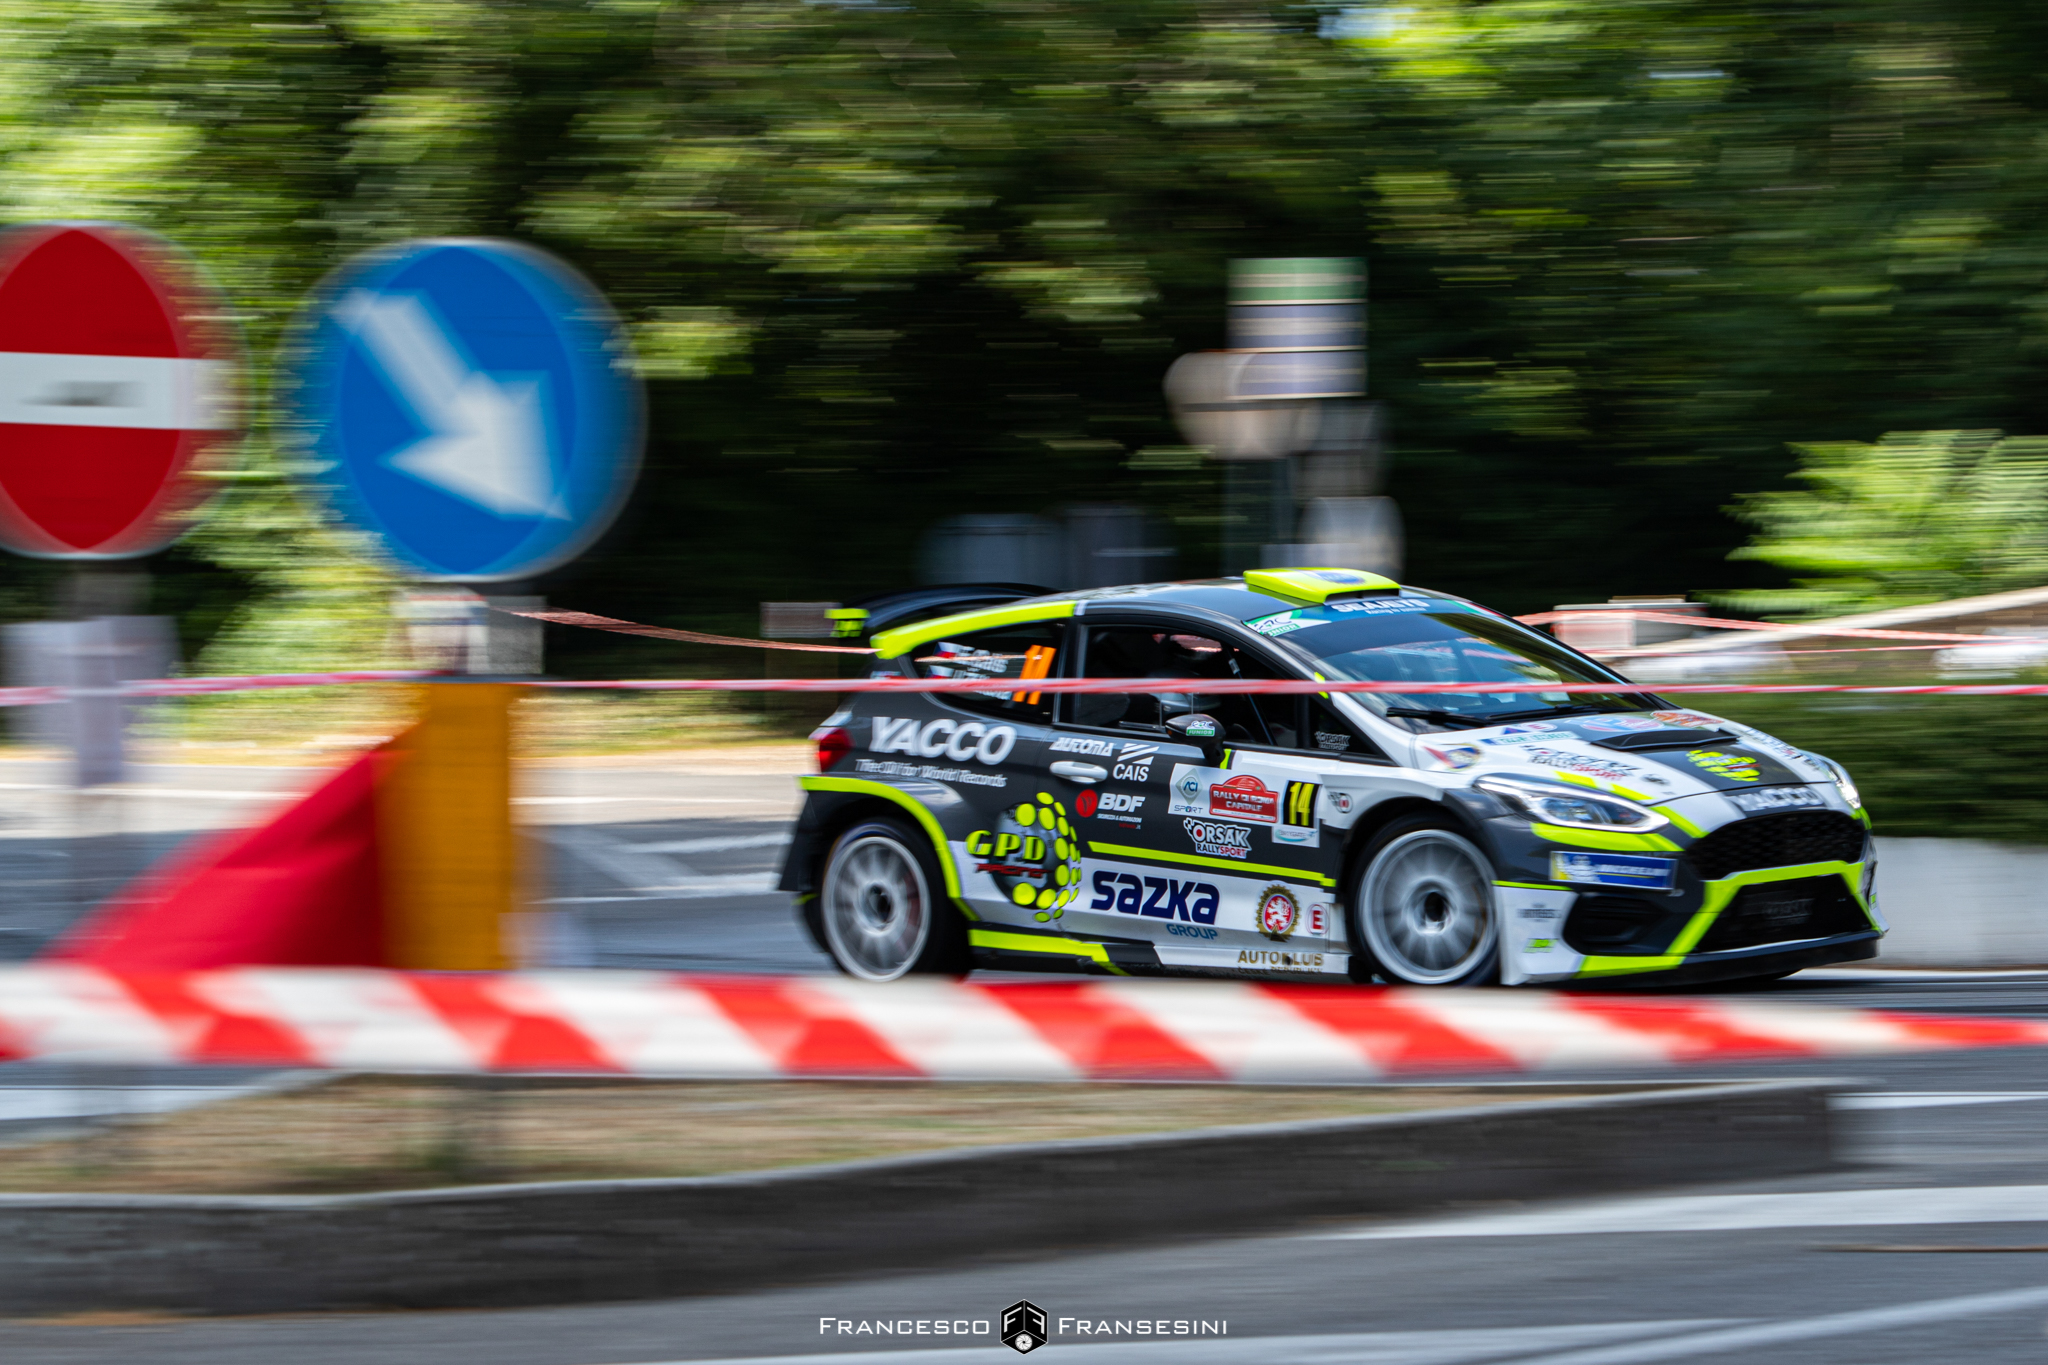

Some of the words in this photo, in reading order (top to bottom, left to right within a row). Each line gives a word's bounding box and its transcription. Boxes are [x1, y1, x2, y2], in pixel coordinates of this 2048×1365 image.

[869, 716, 1017, 765] YACCO
[1113, 763, 1149, 782] CAIS
[1183, 781, 1198, 792] ACI
[1213, 790, 1239, 800] RALLY
[1098, 793, 1145, 812] BDF
[1174, 805, 1203, 813] SPORT
[1289, 782, 1315, 826] 14
[1193, 823, 1248, 847] ORSAK
[1196, 843, 1246, 857] RALLYSPORT
[1312, 910, 1323, 930] E
[1166, 923, 1218, 940] GROUP
